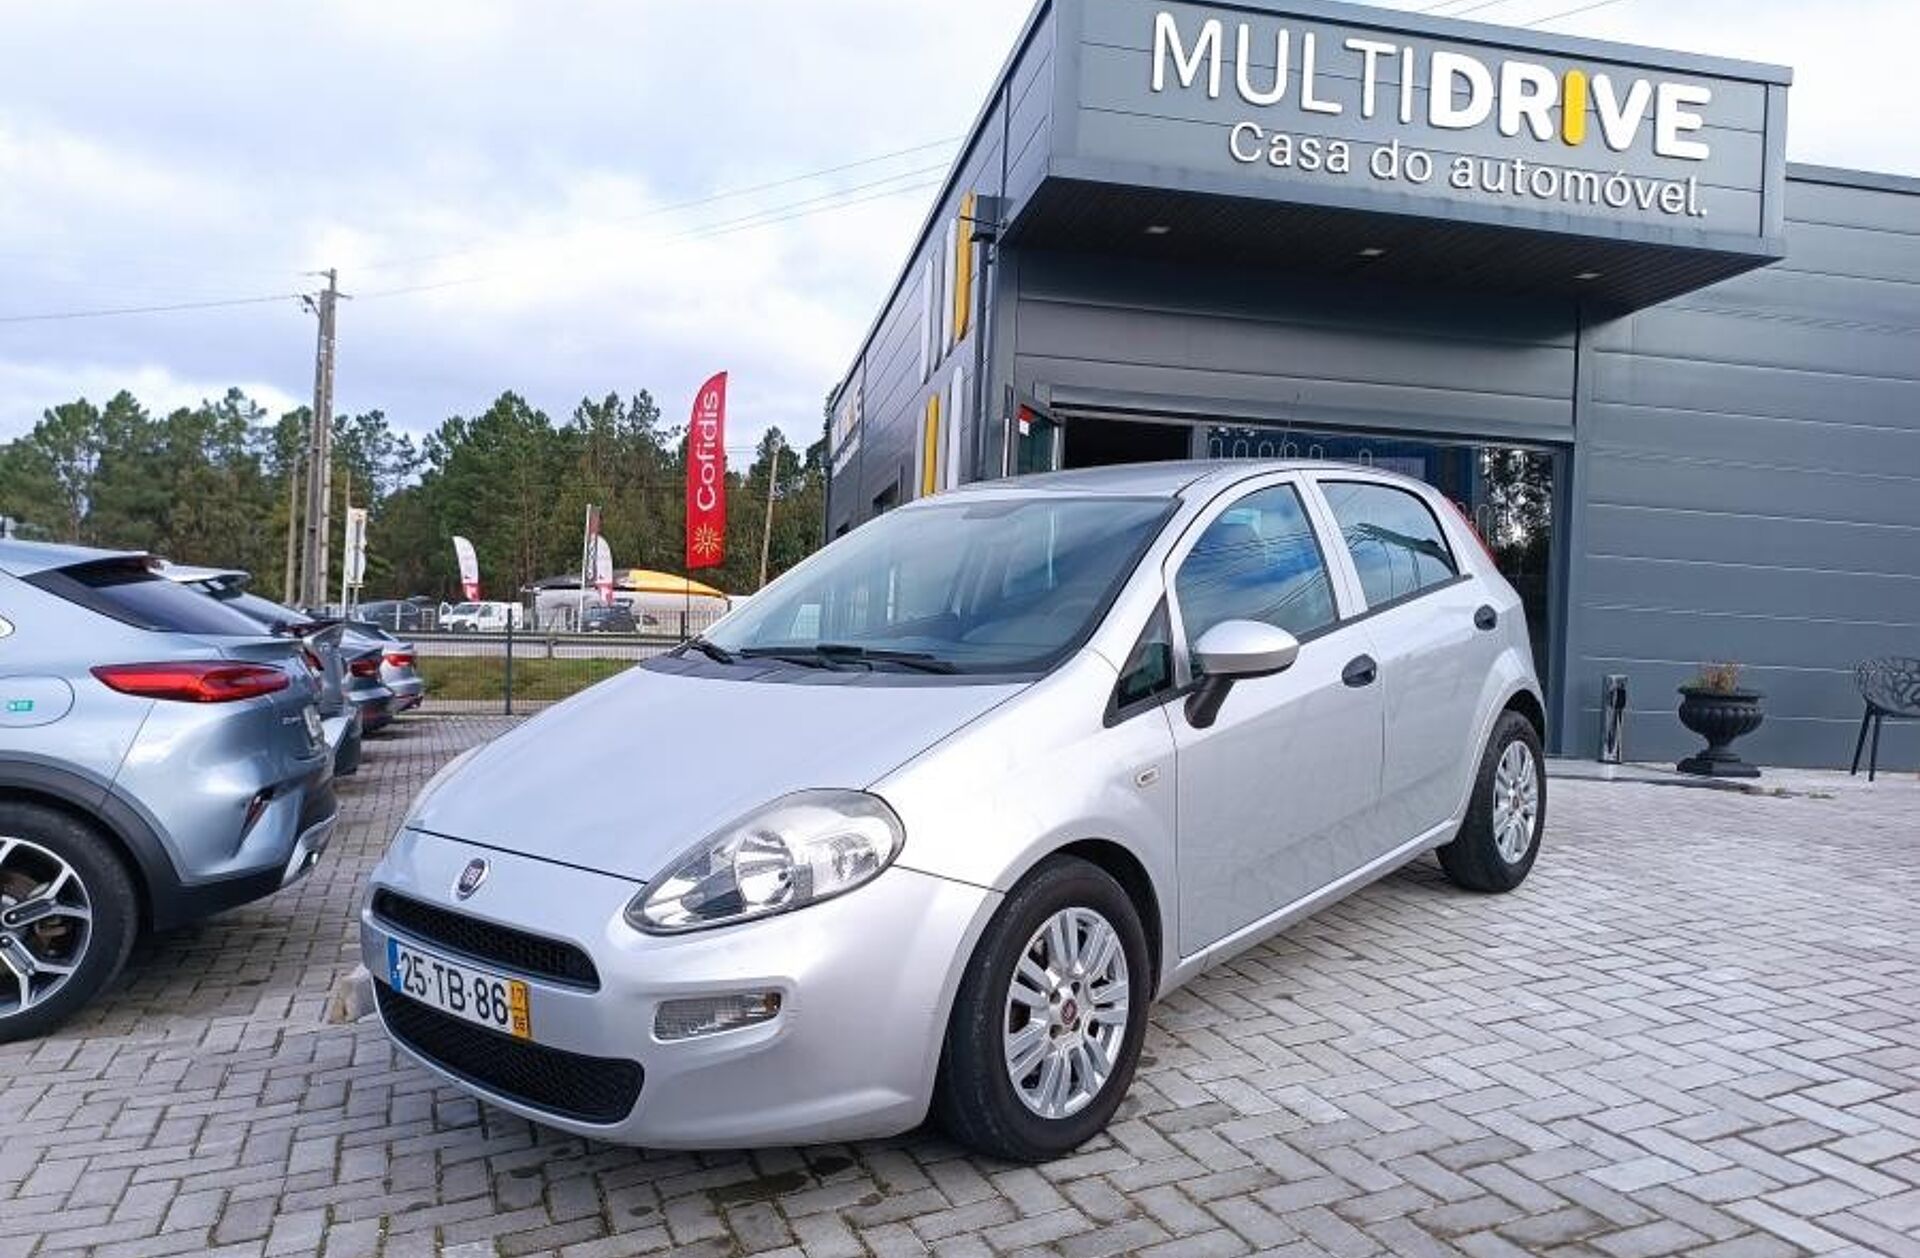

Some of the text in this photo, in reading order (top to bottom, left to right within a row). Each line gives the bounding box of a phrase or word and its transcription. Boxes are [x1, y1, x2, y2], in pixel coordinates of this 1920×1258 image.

[1152, 12, 1711, 160] MULTIDRIVE
[1229, 121, 1707, 217] Casa do automóvel.
[696, 391, 718, 512] Cofidis
